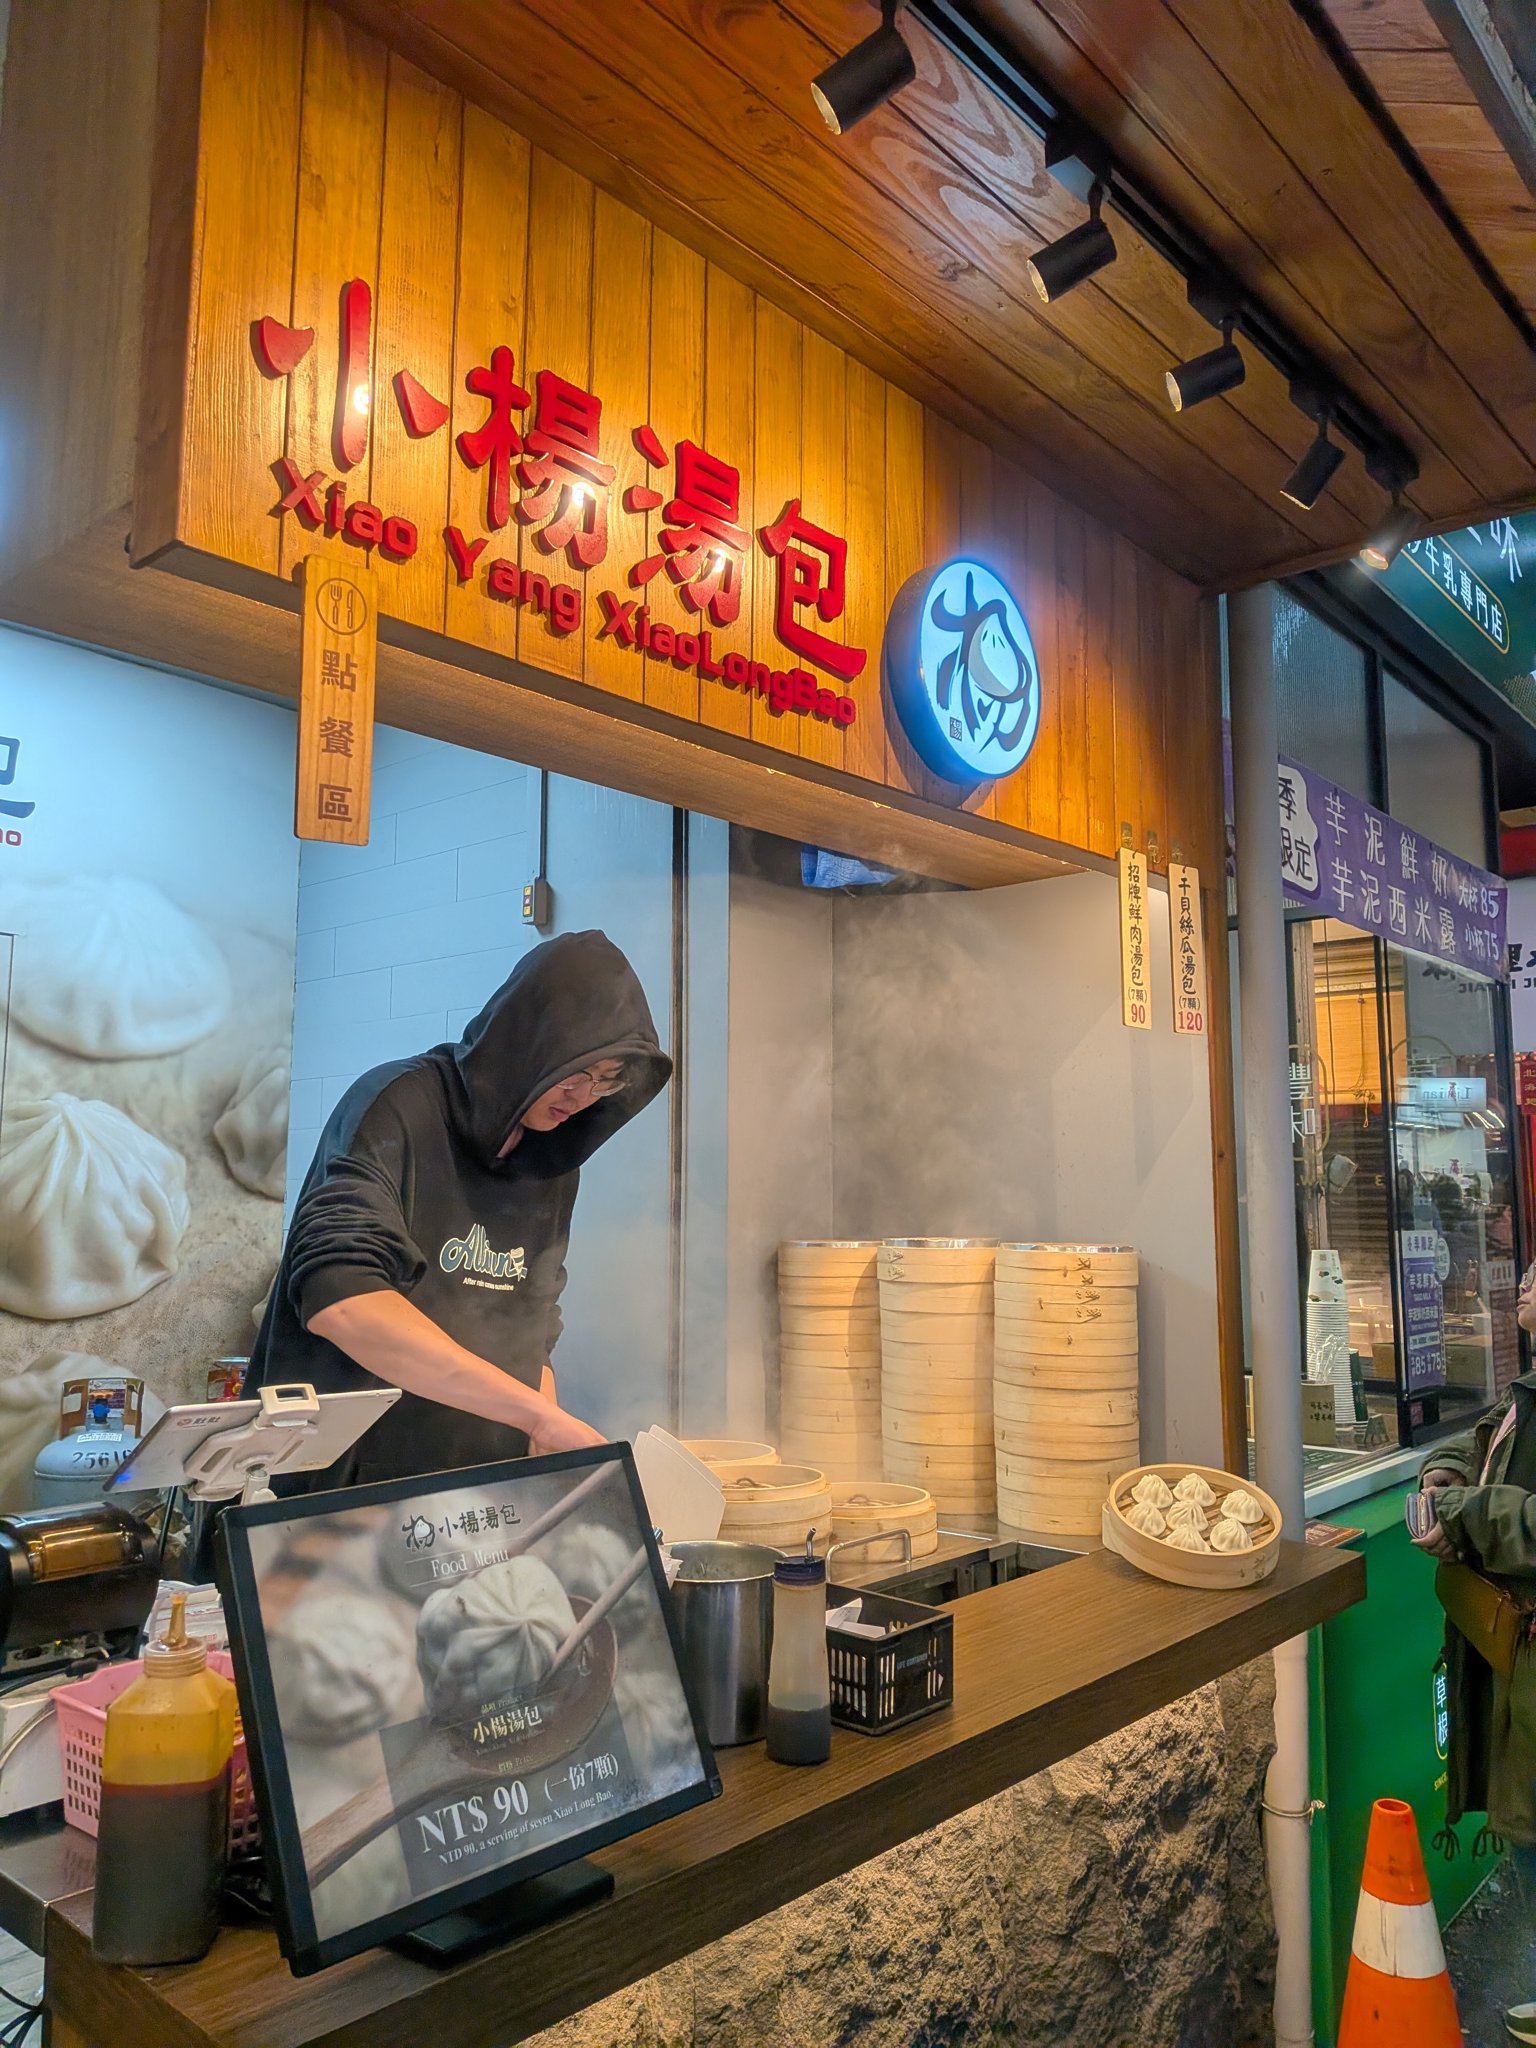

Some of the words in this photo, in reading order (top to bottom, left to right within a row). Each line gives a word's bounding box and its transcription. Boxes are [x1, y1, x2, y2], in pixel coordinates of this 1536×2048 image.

[251, 278, 867, 681] 小楊湯包
[273, 456, 417, 558] Xiao
[443, 525, 581, 632] Yang
[317, 648, 358, 823] 點餐區
[1324, 791, 1449, 900] 芋泥鮮奶
[1127, 861, 1144, 987] 招牌鮮肉湯包
[1178, 877, 1196, 995] 干貝絲瓜湯包
[1331, 857, 1456, 956] 芋泥西米露
[1131, 1004, 1146, 1025] 90
[1178, 1011, 1203, 1032] 120
[431, 1554, 468, 1577] Food
[473, 1549, 510, 1567] Menu
[439, 1503, 521, 1538] 小楊湯包
[473, 1705, 542, 1744] 小楊湯包
[416, 1795, 488, 1854] NT$
[493, 1780, 529, 1824] 90
[487, 1828, 518, 1847] serving
[520, 1821, 529, 1833] of
[530, 1814, 552, 1829] seven
[554, 1806, 573, 1820] Xiao
[574, 1797, 596, 1812] Long
